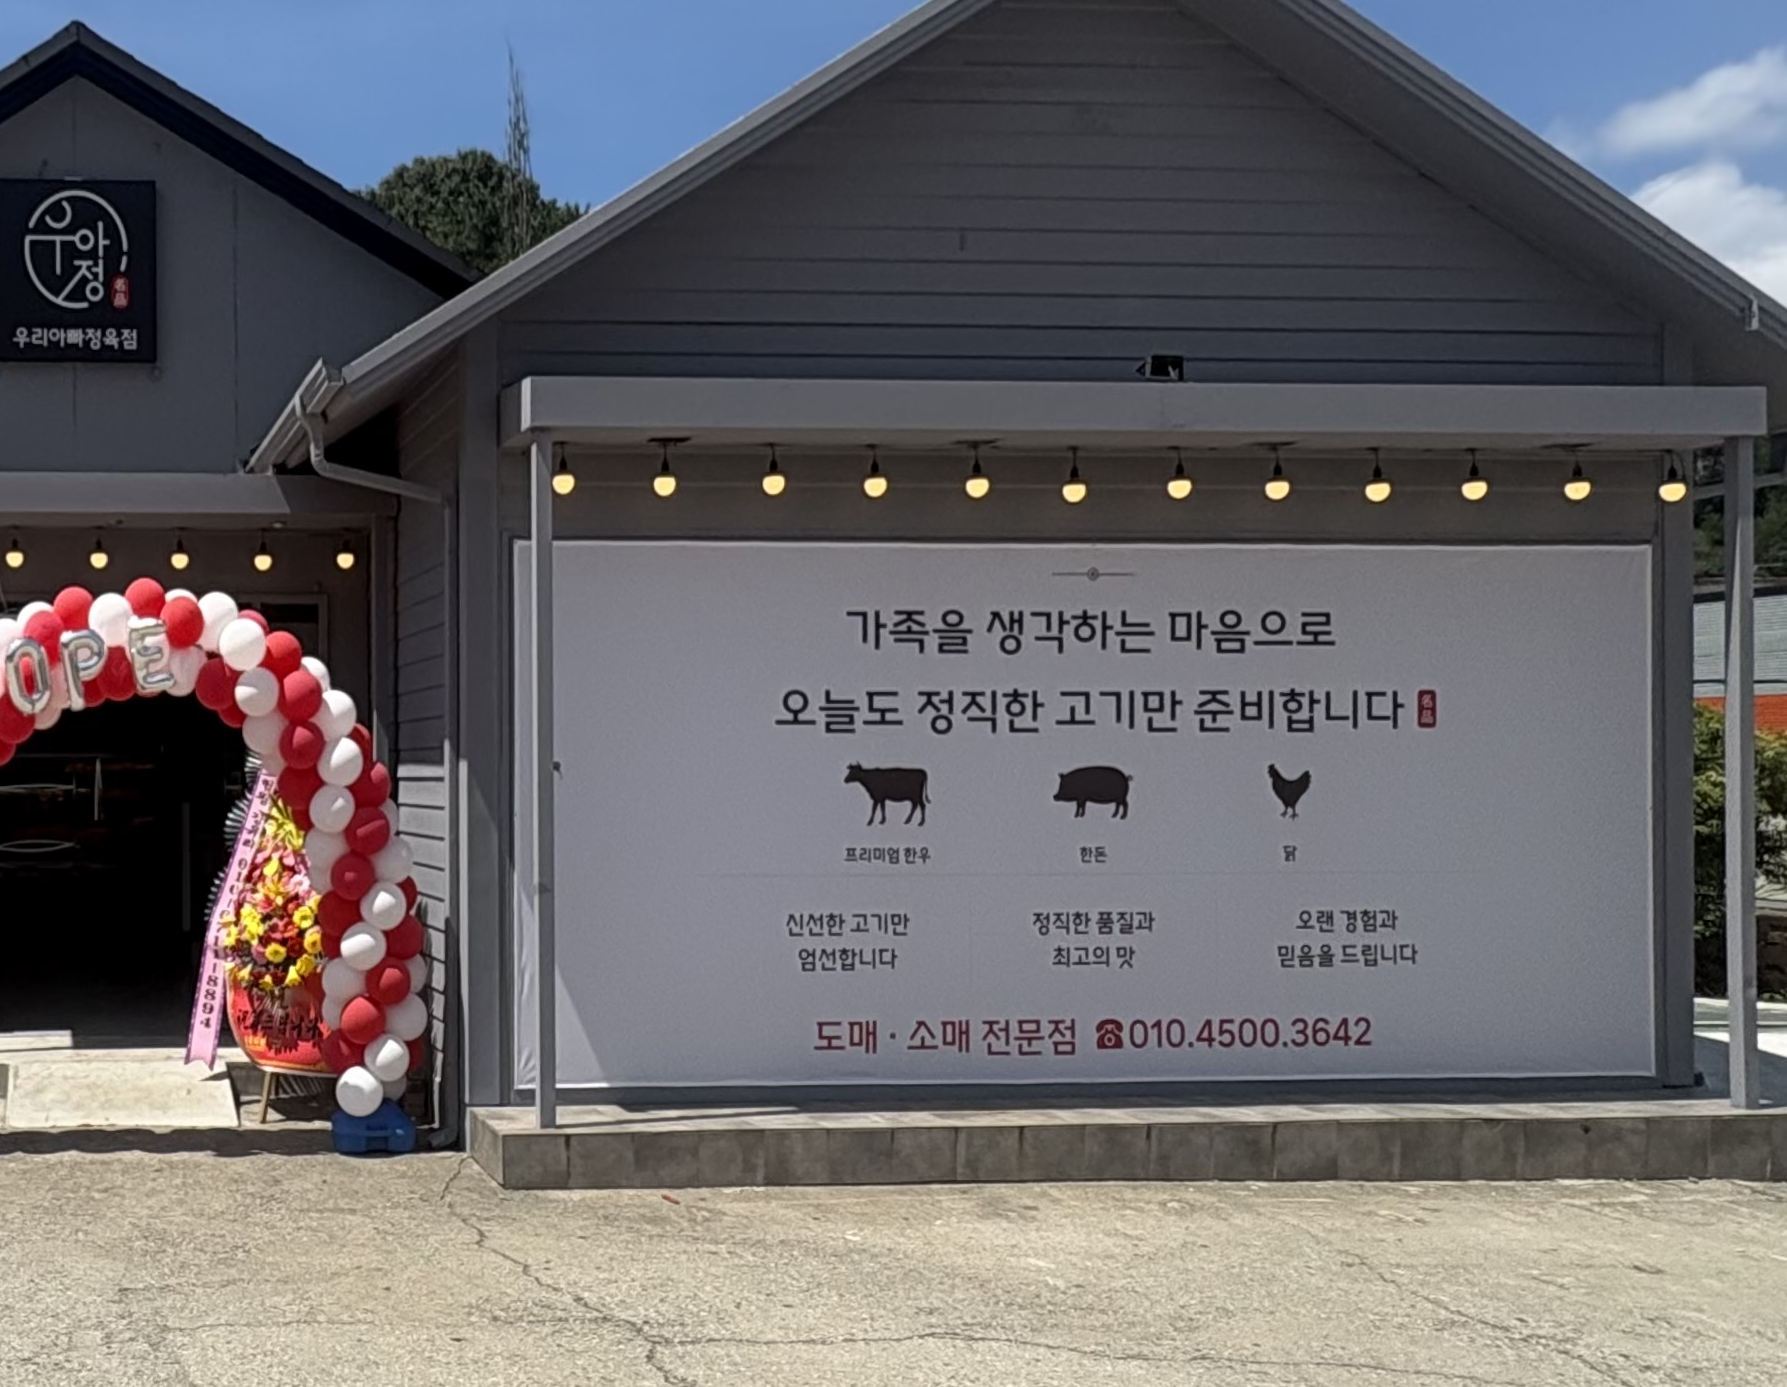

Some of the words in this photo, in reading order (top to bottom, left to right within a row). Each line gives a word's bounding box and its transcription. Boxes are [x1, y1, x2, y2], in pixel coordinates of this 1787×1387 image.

[13, 327, 138, 350] 우리아빠정육점
[847, 610, 973, 654] 가족을
[987, 610, 1155, 655] 생각하는
[1169, 610, 1335, 654] 마음으로
[775, 690, 903, 733] 오늘도
[918, 689, 1044, 734] 정직한
[1056, 690, 1183, 732] 고기만
[1194, 688, 1404, 732] 준비합니다
[845, 847, 899, 864] 프리미엄
[904, 847, 930, 864] 한우
[1080, 847, 1107, 863] 한돈
[1283, 846, 1297, 862] 닭
[787, 913, 845, 936] 신선한
[850, 913, 910, 936] 고기만
[1033, 912, 1091, 936] 정직한
[1096, 912, 1155, 934] 품질과
[1296, 910, 1334, 933] 오랜
[1340, 909, 1398, 933] 경험과
[799, 948, 897, 972] 엄선합니다
[1053, 946, 1109, 967] 최고의
[1116, 946, 1135, 969] 맛
[1278, 944, 1335, 968] 믿음을
[1341, 944, 1418, 967] 드립니다
[814, 1021, 877, 1054] 도매
[907, 1020, 969, 1053] 소매
[982, 1019, 1075, 1056] 전문점
[1130, 1017, 1372, 1048] 010.4500.3642
